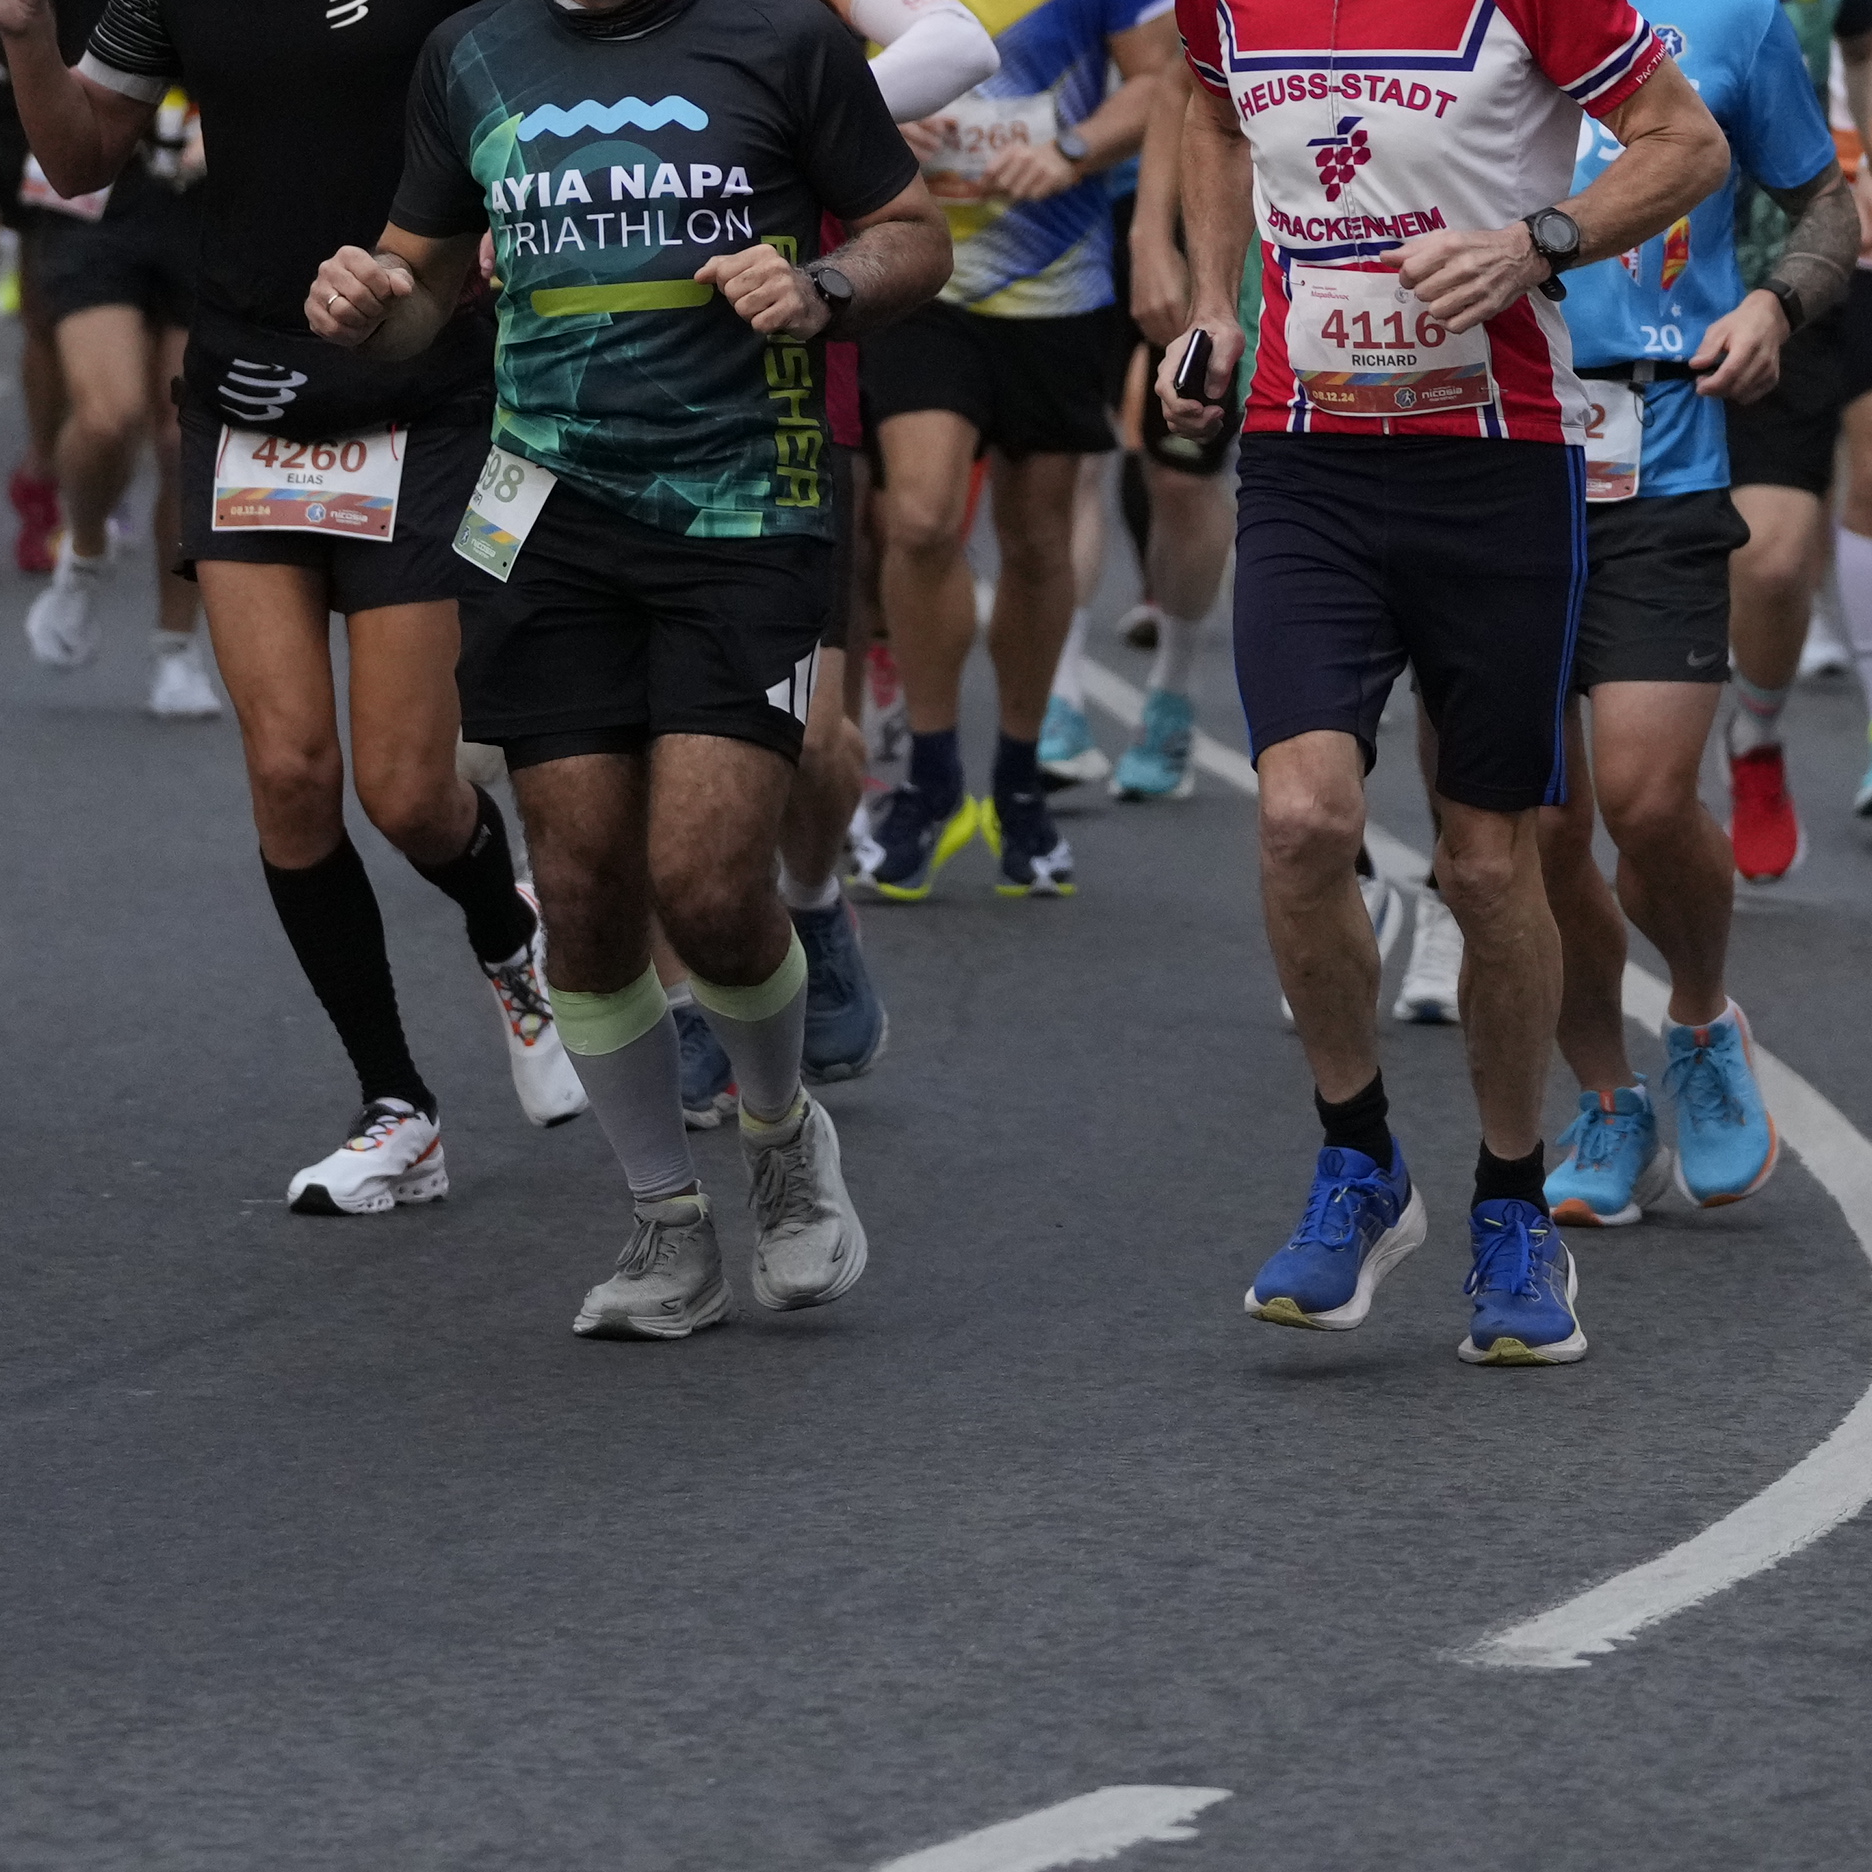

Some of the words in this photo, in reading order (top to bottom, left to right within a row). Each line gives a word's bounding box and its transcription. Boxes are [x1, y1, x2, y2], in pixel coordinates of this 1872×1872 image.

[1237, 73, 1458, 122] HEUSS-STADT
[491, 169, 593, 214] AYIA
[610, 162, 754, 202] NAPA
[498, 205, 754, 258] TRIATHLON
[1267, 201, 1447, 243] BRACKENHEIM
[1321, 309, 1446, 350] 4116
[1639, 323, 1684, 352] 20
[1351, 354, 1417, 367] RICHARD
[1312, 389, 1355, 403] 08.12.24
[1421, 387, 1463, 399] nicosia
[252, 437, 367, 473] 4260
[287, 473, 324, 485] ELIAS
